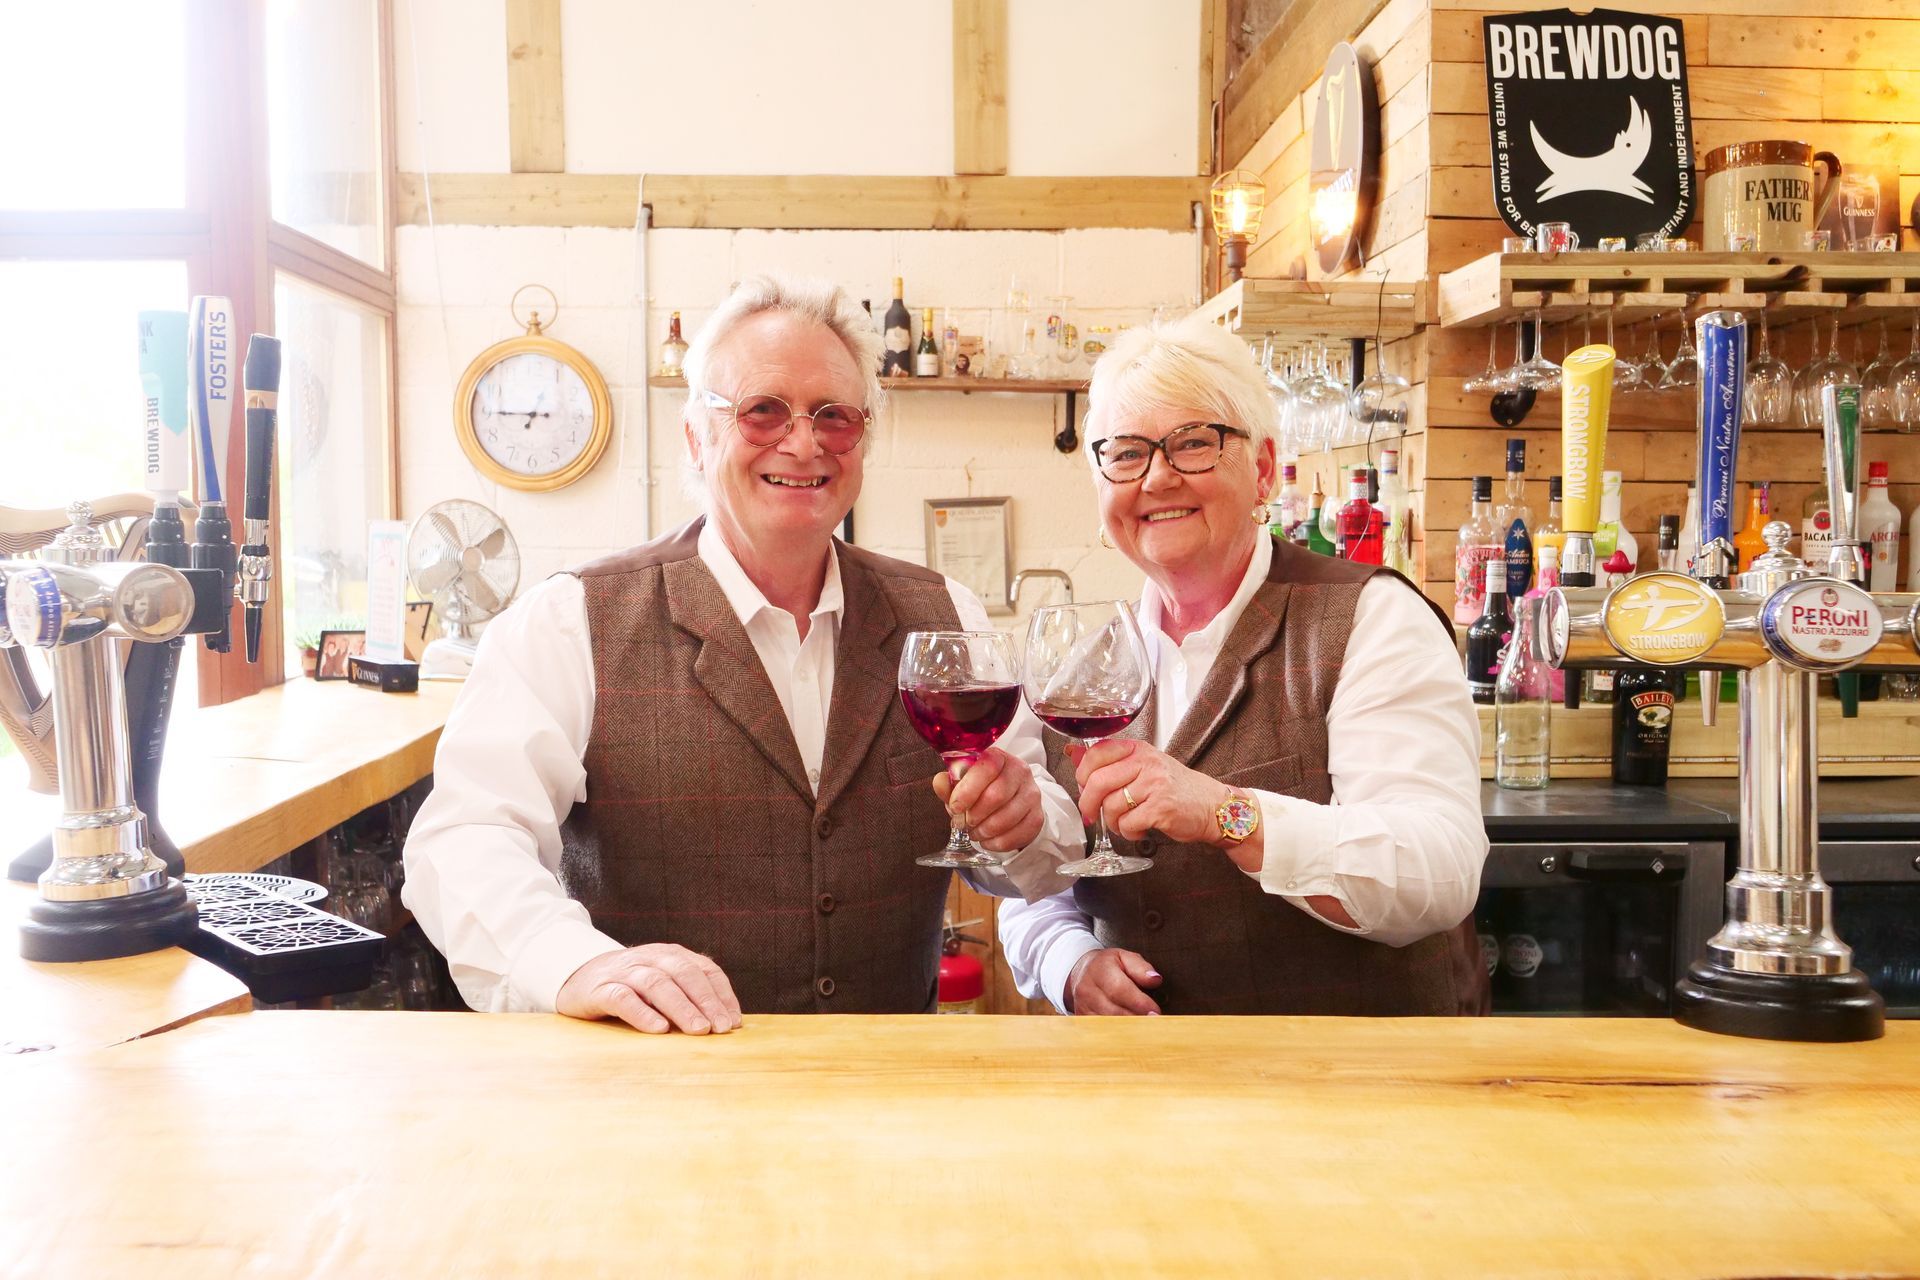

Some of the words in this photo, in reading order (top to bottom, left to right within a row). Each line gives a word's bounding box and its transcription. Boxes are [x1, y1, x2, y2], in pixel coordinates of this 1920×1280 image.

[1490, 24, 1681, 80] BREWDOG
[1494, 82, 1506, 127] UNITED
[1672, 84, 1688, 169] INDEPENDENT
[1497, 130, 1508, 149] WE
[1499, 153, 1511, 193] STAND
[1679, 172, 1690, 197] AND
[1503, 196, 1522, 221] FOR
[1767, 202, 1802, 222] MUG
[1843, 206, 1876, 217] GUINNESS
[210, 311, 227, 401] FOSTER'S
[1719, 338, 1736, 411] Azzurro
[147, 397, 160, 474] BREWDOG
[1566, 384, 1591, 501] STRONGBOW
[1716, 411, 1733, 466] Nastro
[1713, 468, 1729, 519] Peroni
[1804, 532, 1833, 542] BACAR
[1870, 531, 1899, 542] ARCH
[1792, 605, 1868, 627] PERONI
[1629, 631, 1707, 651] STRONGBOW
[1792, 625, 1828, 636] NASTRO
[1830, 627, 1870, 637] AZZURRO
[356, 667, 380, 683] GUINNESS
[1635, 693, 1674, 706] BAILEYS
